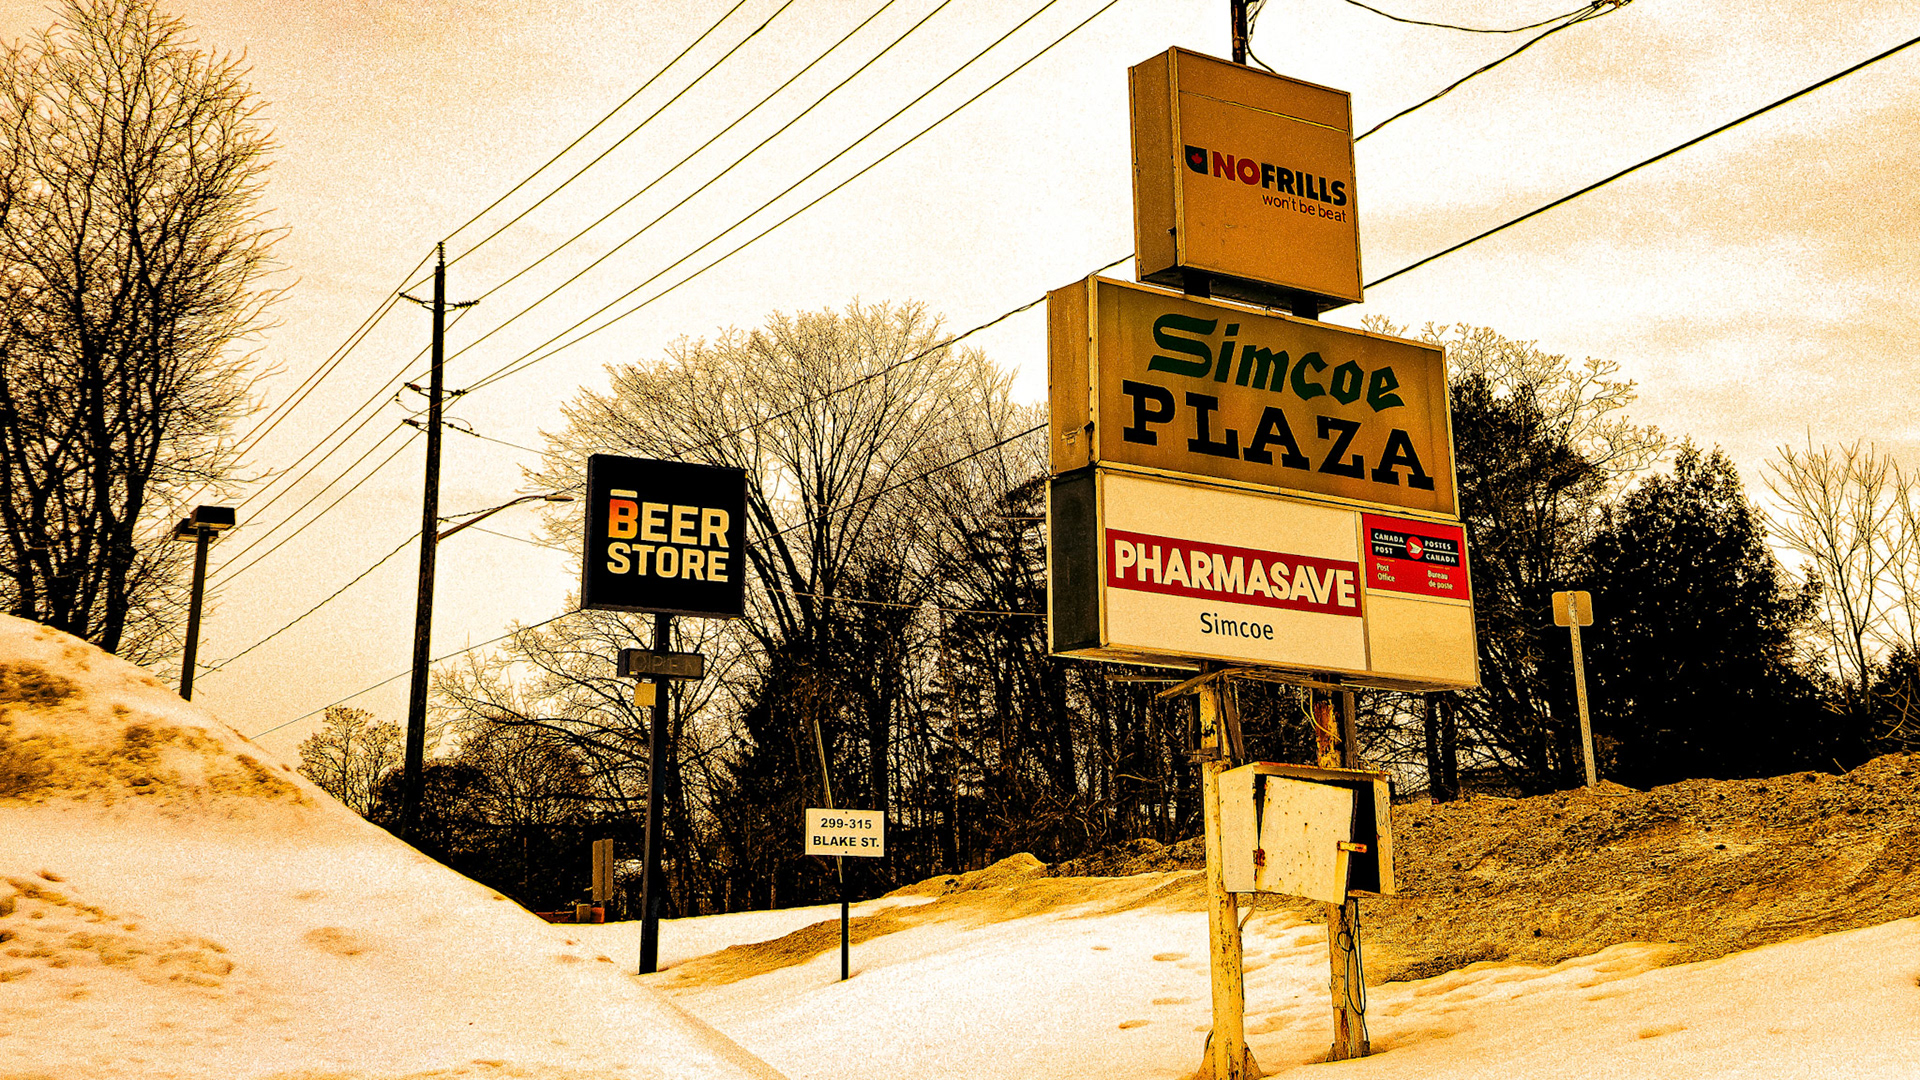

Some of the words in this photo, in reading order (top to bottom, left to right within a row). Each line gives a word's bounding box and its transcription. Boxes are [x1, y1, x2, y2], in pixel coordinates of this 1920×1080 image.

[1262, 194, 1297, 212] won't
[1299, 199, 1316, 216] be
[1318, 204, 1347, 223] beat
[1147, 313, 1405, 413] Simcoe
[1122, 379, 1435, 491] PLAZA
[607, 498, 729, 548] BEER
[1374, 533, 1404, 543] CANADA
[1375, 546, 1393, 555] POST
[1425, 540, 1451, 550] POSTES
[606, 542, 729, 583] STORE
[1425, 553, 1456, 564] CANADA
[1376, 563, 1389, 572] Post
[1114, 539, 1357, 608] PHARMASAVE
[1377, 572, 1395, 582] Office
[1427, 570, 1448, 580] Bureau
[1428, 579, 1437, 587] de
[1437, 582, 1453, 590] poste
[1200, 612, 1275, 640] Simcoe
[820, 818, 872, 829] 299-315
[813, 835, 857, 847] BLAKE
[861, 837, 880, 848] ST.
